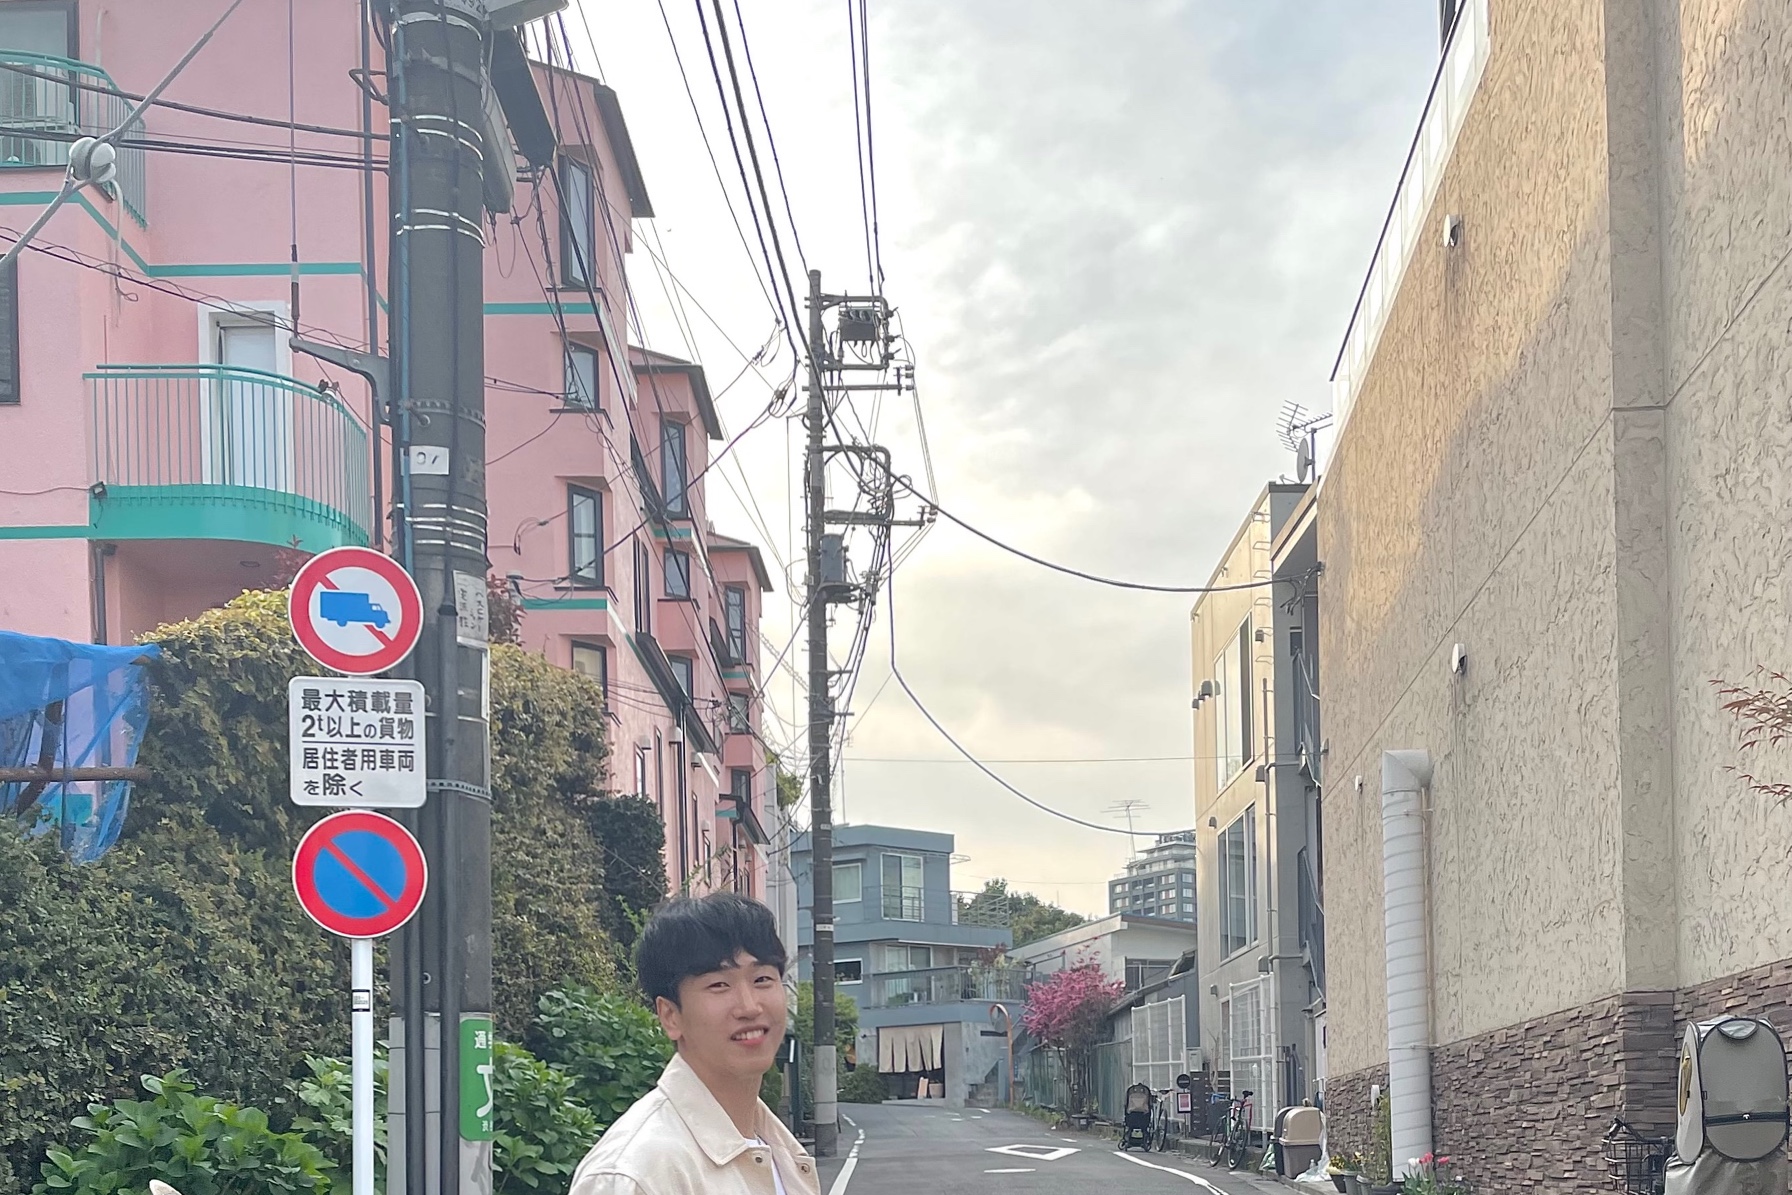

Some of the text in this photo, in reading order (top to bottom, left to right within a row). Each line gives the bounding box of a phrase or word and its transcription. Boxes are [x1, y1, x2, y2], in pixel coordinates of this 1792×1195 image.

[301, 688, 414, 715] 最大積載量
[301, 714, 414, 740] 2t以上の貨物
[302, 747, 415, 772] 居住者用車両
[303, 773, 364, 797] を除く
